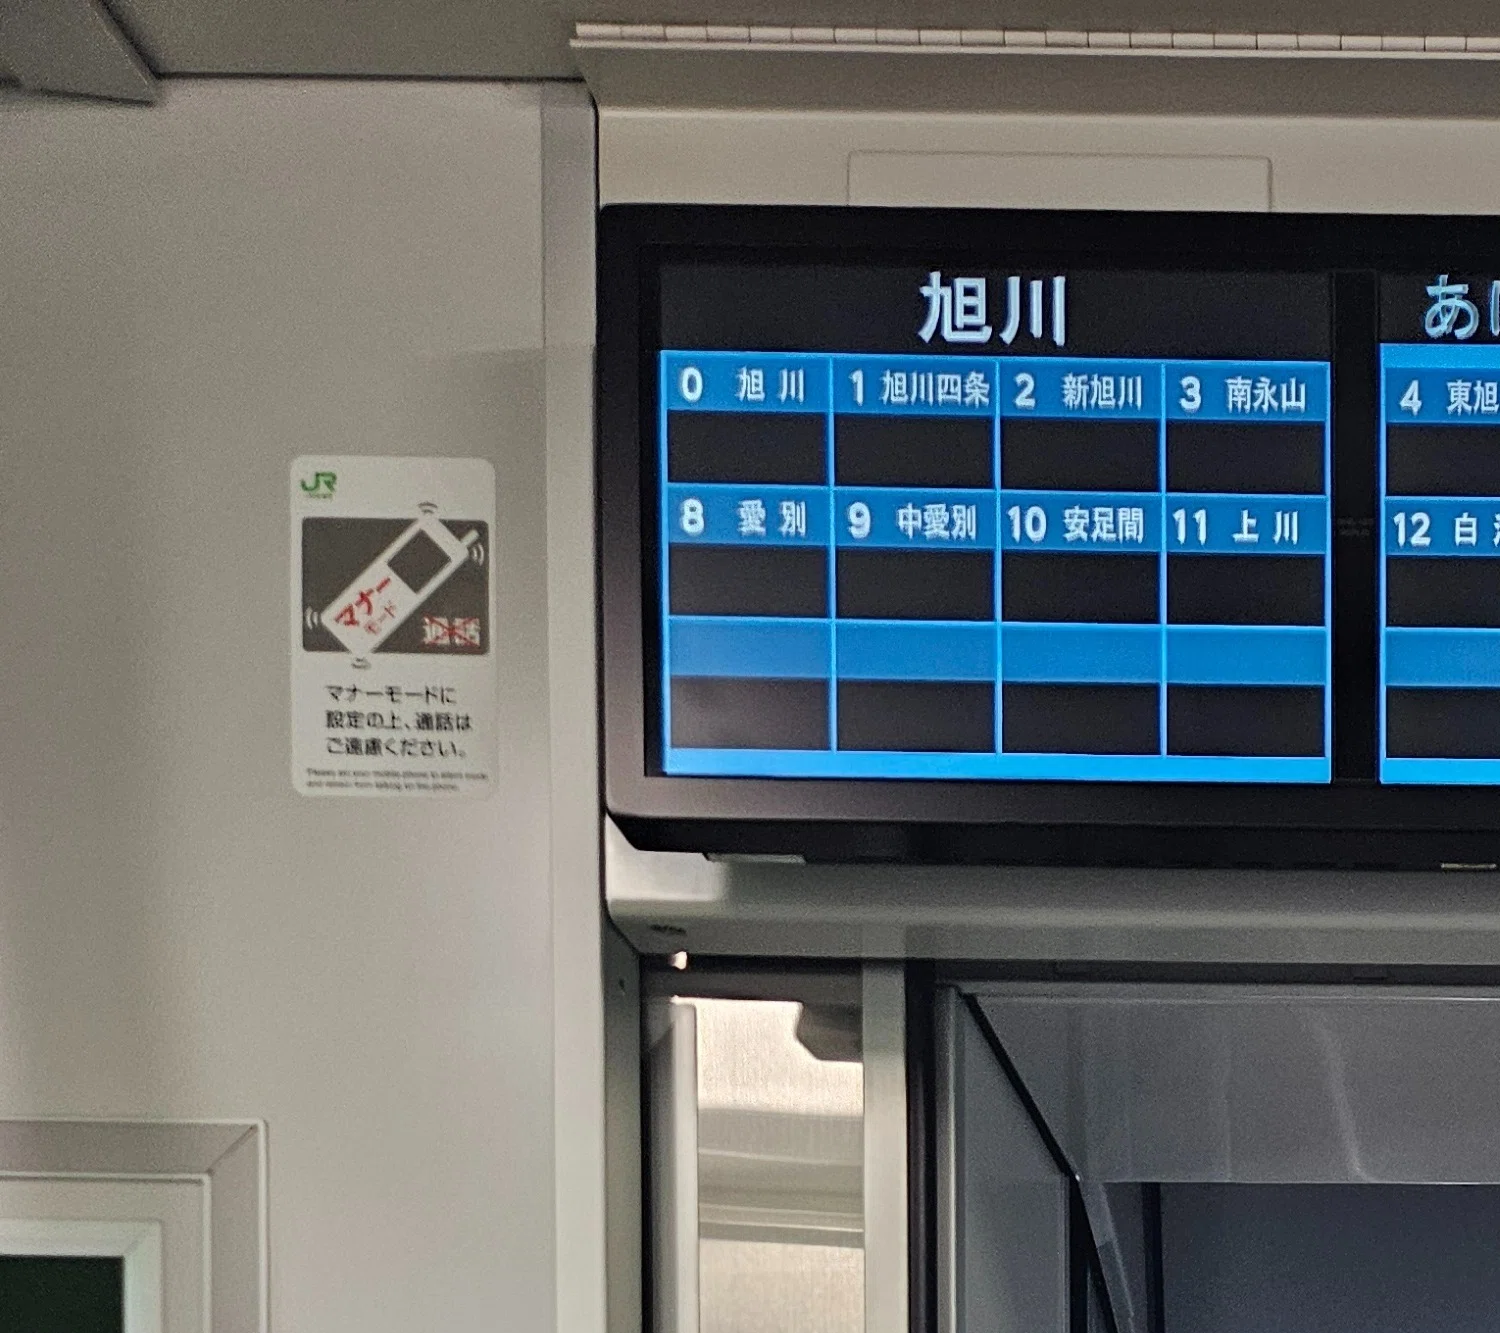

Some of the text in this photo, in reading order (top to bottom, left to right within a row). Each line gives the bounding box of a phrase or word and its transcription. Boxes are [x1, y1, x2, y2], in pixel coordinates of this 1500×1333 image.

[919, 271, 1067, 346] 旭川
[680, 366, 806, 402] 0 旭川
[850, 370, 991, 407] 1 旭川四条
[1014, 373, 1144, 411] 2 新旭川
[1179, 375, 1308, 413] 3 南永山
[1399, 380, 1423, 416] 4
[300, 471, 338, 494] JR
[680, 498, 807, 537] 8 愛別
[848, 501, 978, 541] 9 中愛別
[1008, 505, 1145, 543] 10 安足間
[1172, 508, 1208, 545] 11
[1232, 510, 1299, 545] 上川
[1392, 513, 1431, 548] 12
[335, 576, 392, 627] マナー
[324, 684, 457, 705] マナーモードに
[324, 709, 472, 733] 設定の上、通話は
[325, 736, 469, 759] ご遠慮ください。
